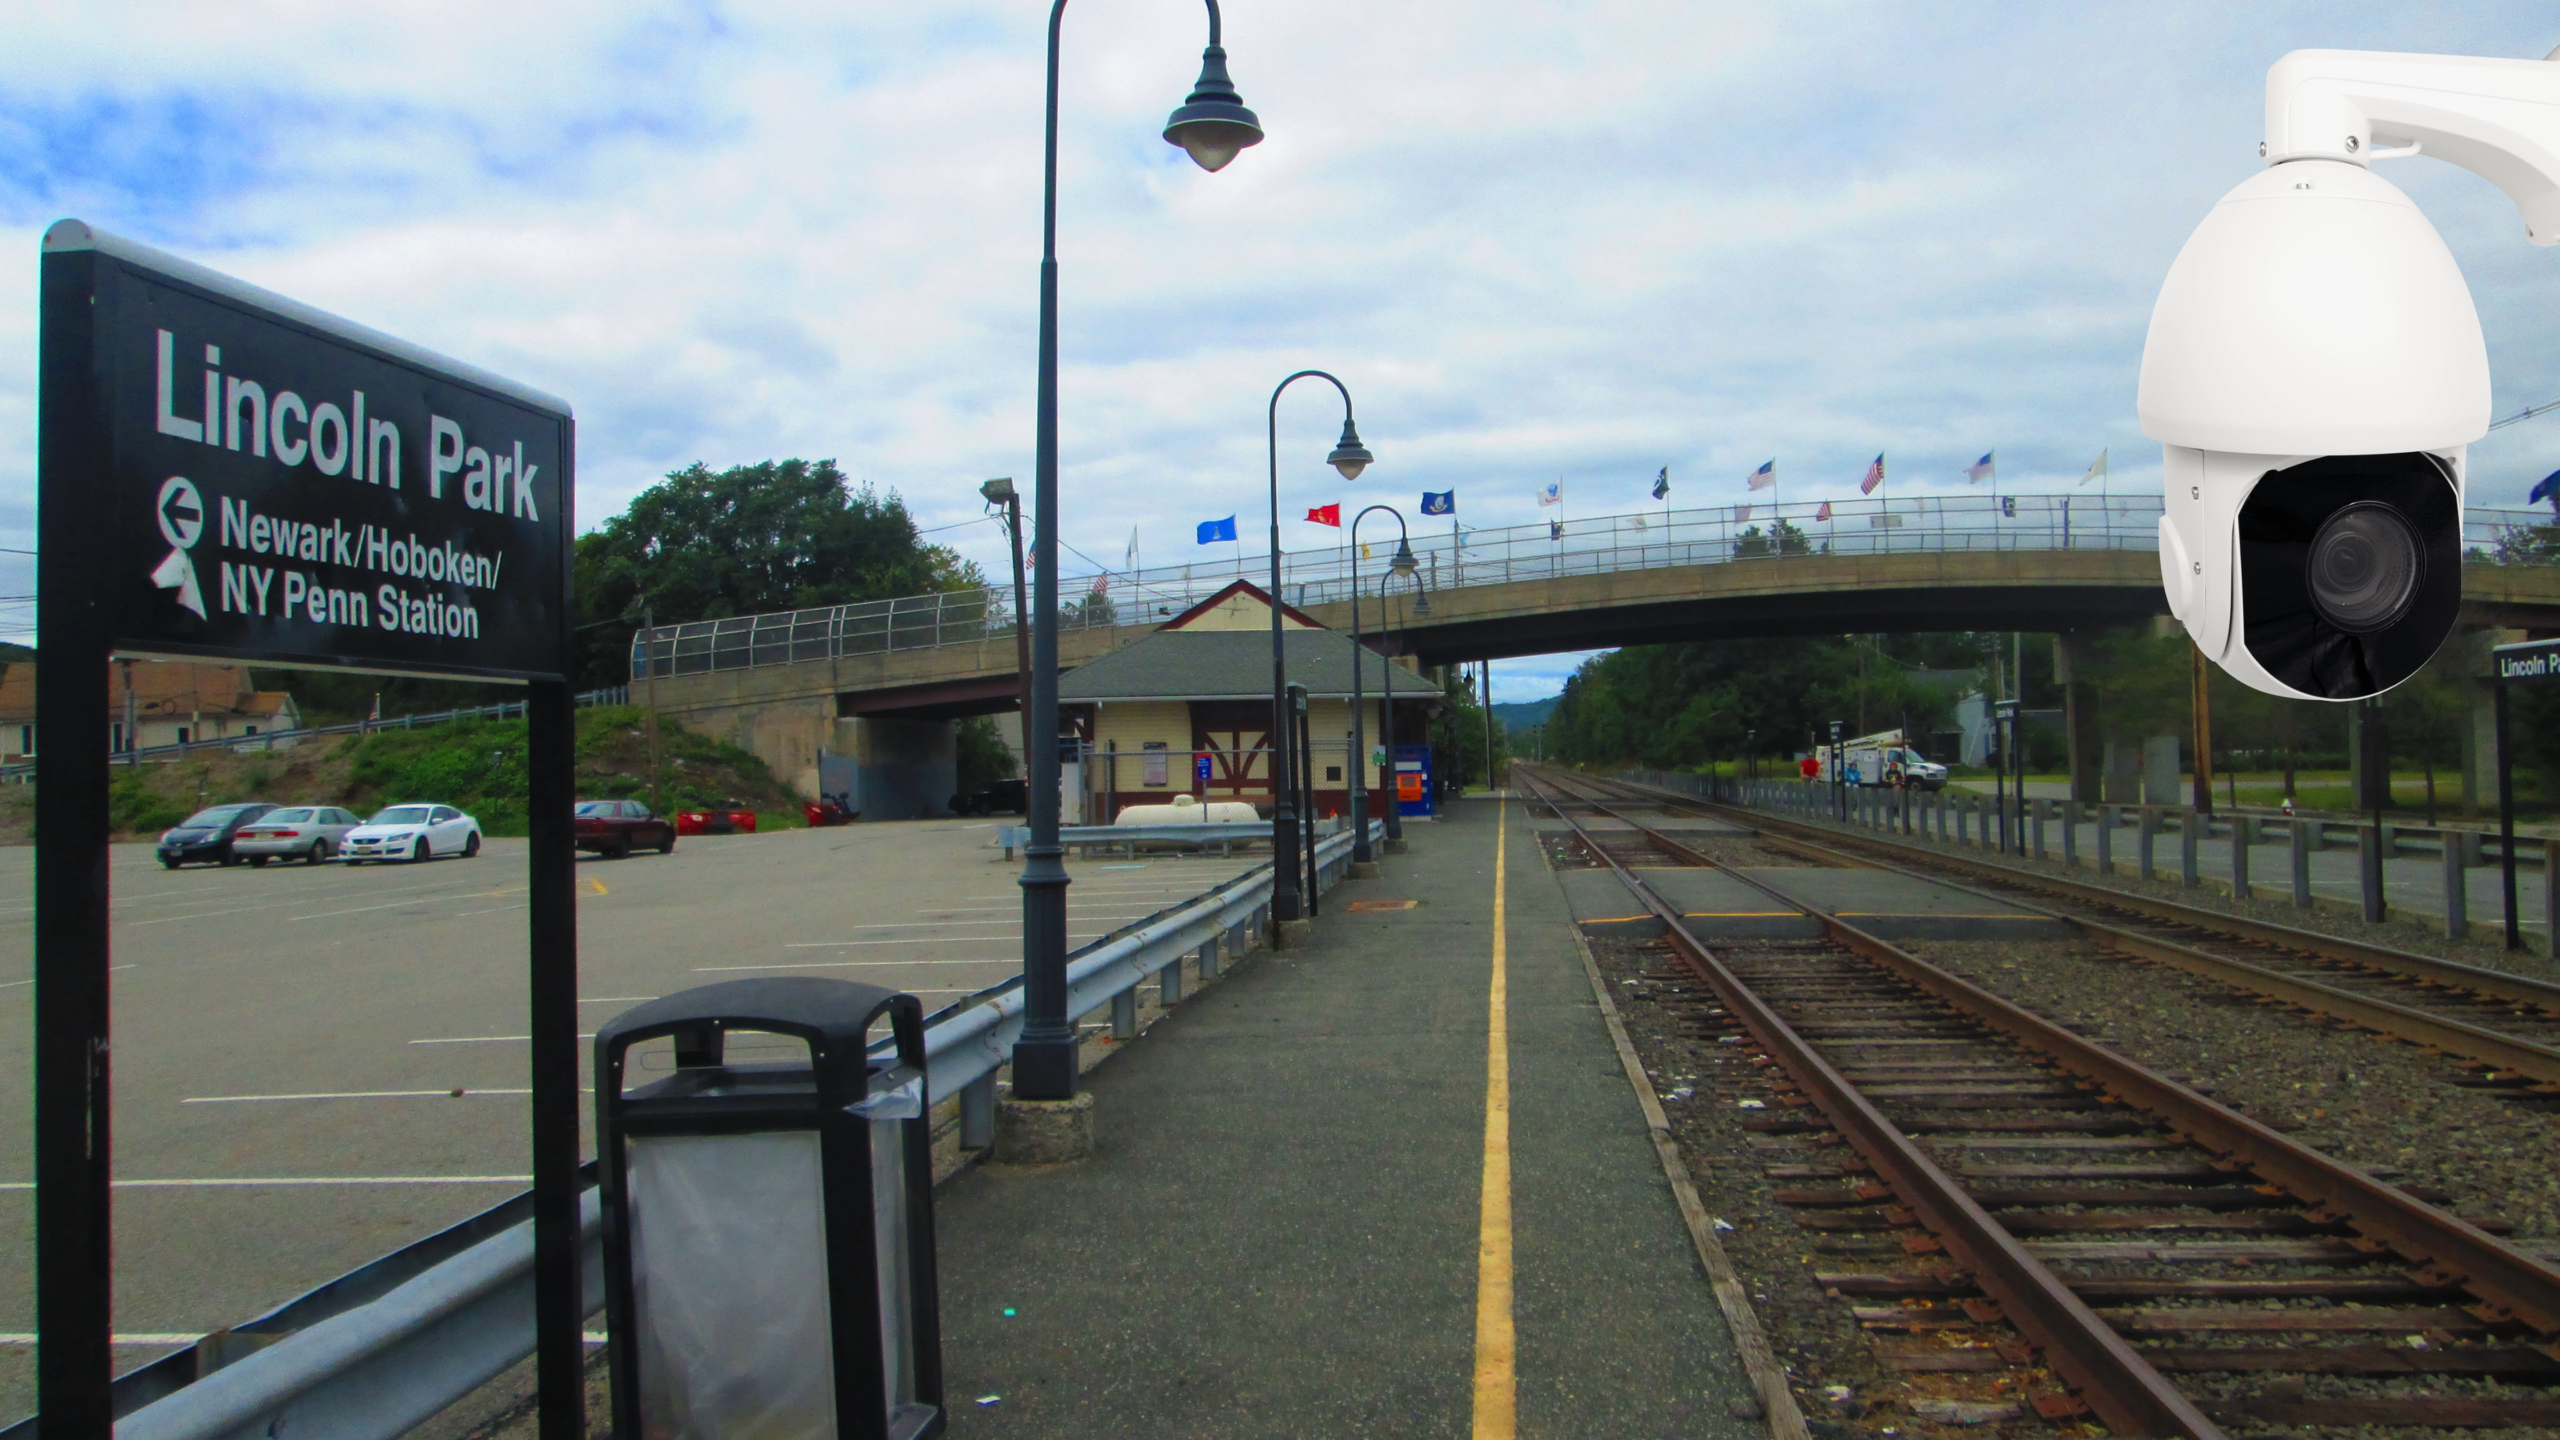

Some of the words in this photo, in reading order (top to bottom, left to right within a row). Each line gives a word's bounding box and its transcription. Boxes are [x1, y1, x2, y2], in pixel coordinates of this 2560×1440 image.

[157, 328, 401, 490] Lincoln
[430, 414, 540, 522] Park
[221, 496, 503, 590] Newark/Hoboken/
[221, 561, 274, 616] NY
[284, 571, 368, 627] Penn
[378, 584, 480, 639] Station
[2501, 655, 2546, 677] Lincoln
